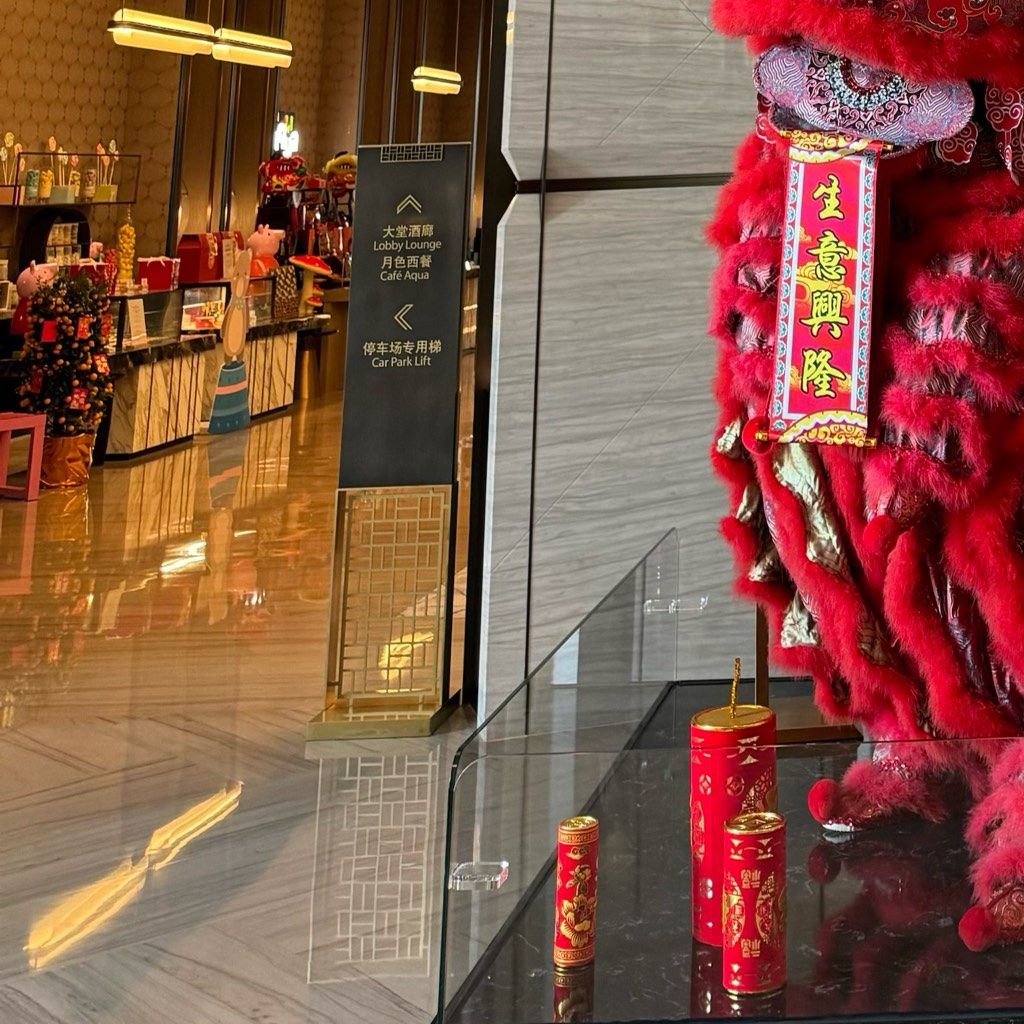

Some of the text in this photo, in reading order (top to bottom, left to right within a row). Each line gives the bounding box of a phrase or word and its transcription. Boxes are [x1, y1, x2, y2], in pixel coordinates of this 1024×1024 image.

[382, 224, 434, 238] 大堂酒廊
[373, 240, 442, 252] Lobby Lounge
[381, 254, 432, 269] 月色西餐
[380, 270, 430, 282] Café Aqua
[800, 173, 849, 398] 生意興隆
[363, 339, 442, 356] 停车场专用梯
[371, 355, 432, 368] Car Park Lift
